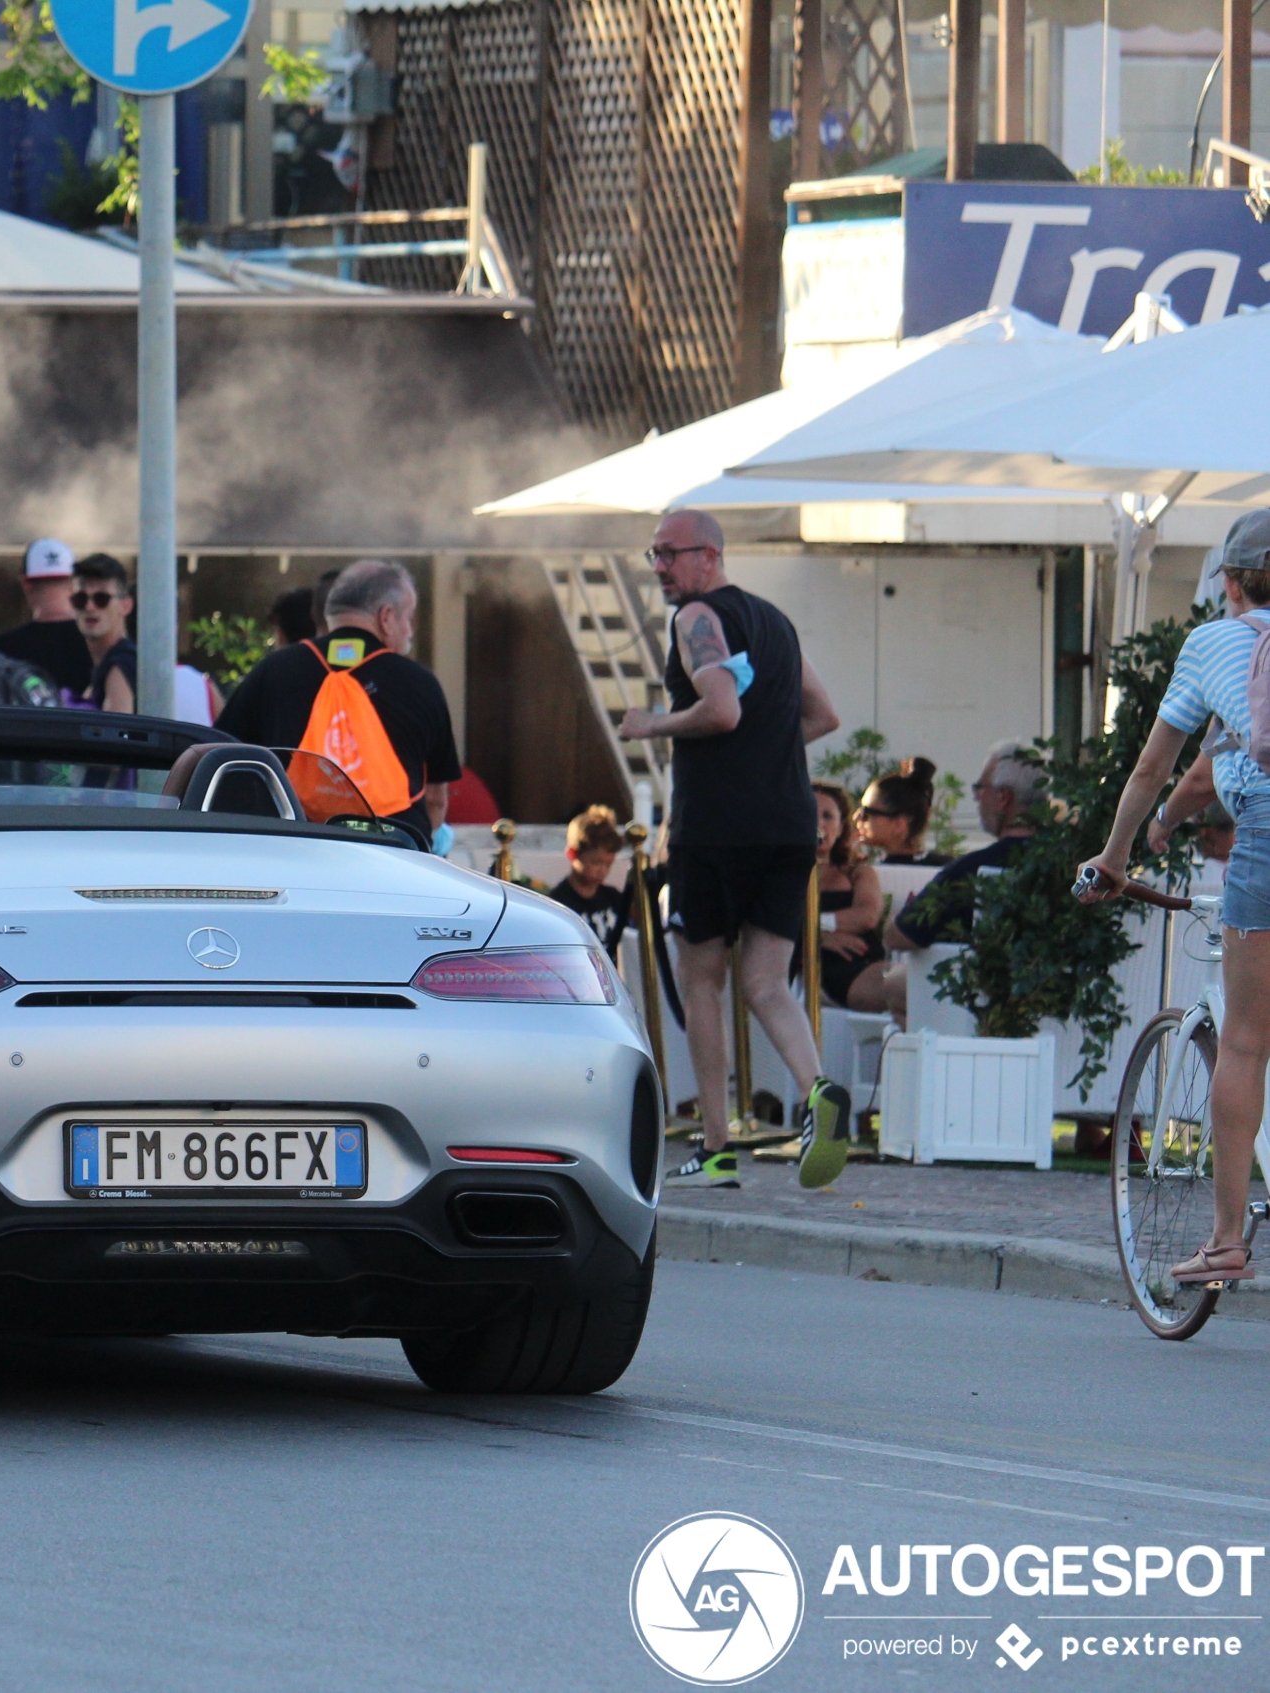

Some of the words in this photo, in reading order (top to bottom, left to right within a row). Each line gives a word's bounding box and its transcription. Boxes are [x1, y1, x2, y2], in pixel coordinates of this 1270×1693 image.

[960, 202, 1270, 335] Tra
[106, 1130, 162, 1180] FM
[183, 1131, 328, 1181] 866FX
[98, 1190, 122, 1198] Crema
[125, 1190, 147, 1198] Diesel
